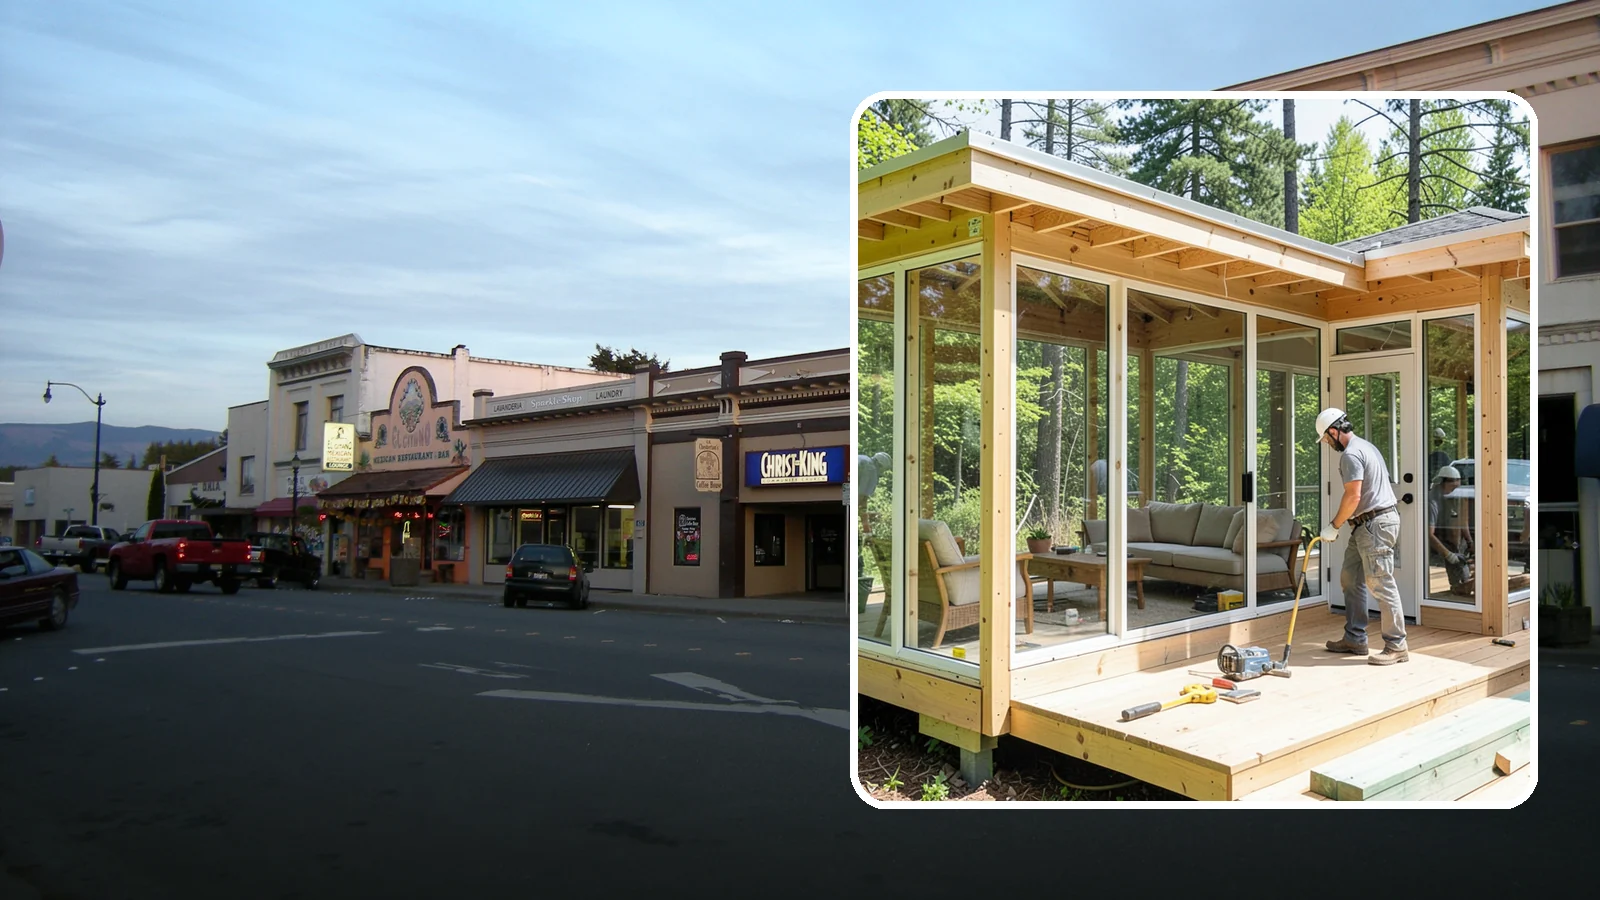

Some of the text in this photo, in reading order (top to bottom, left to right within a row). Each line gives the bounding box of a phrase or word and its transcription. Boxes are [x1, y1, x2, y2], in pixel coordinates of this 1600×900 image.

[494, 389, 624, 412] LAVANDERIA Sparkle Shop LAUNDRY
[373, 450, 450, 464] MEXICAN RESTAURANT BAR
[799, 450, 827, 476] KING
